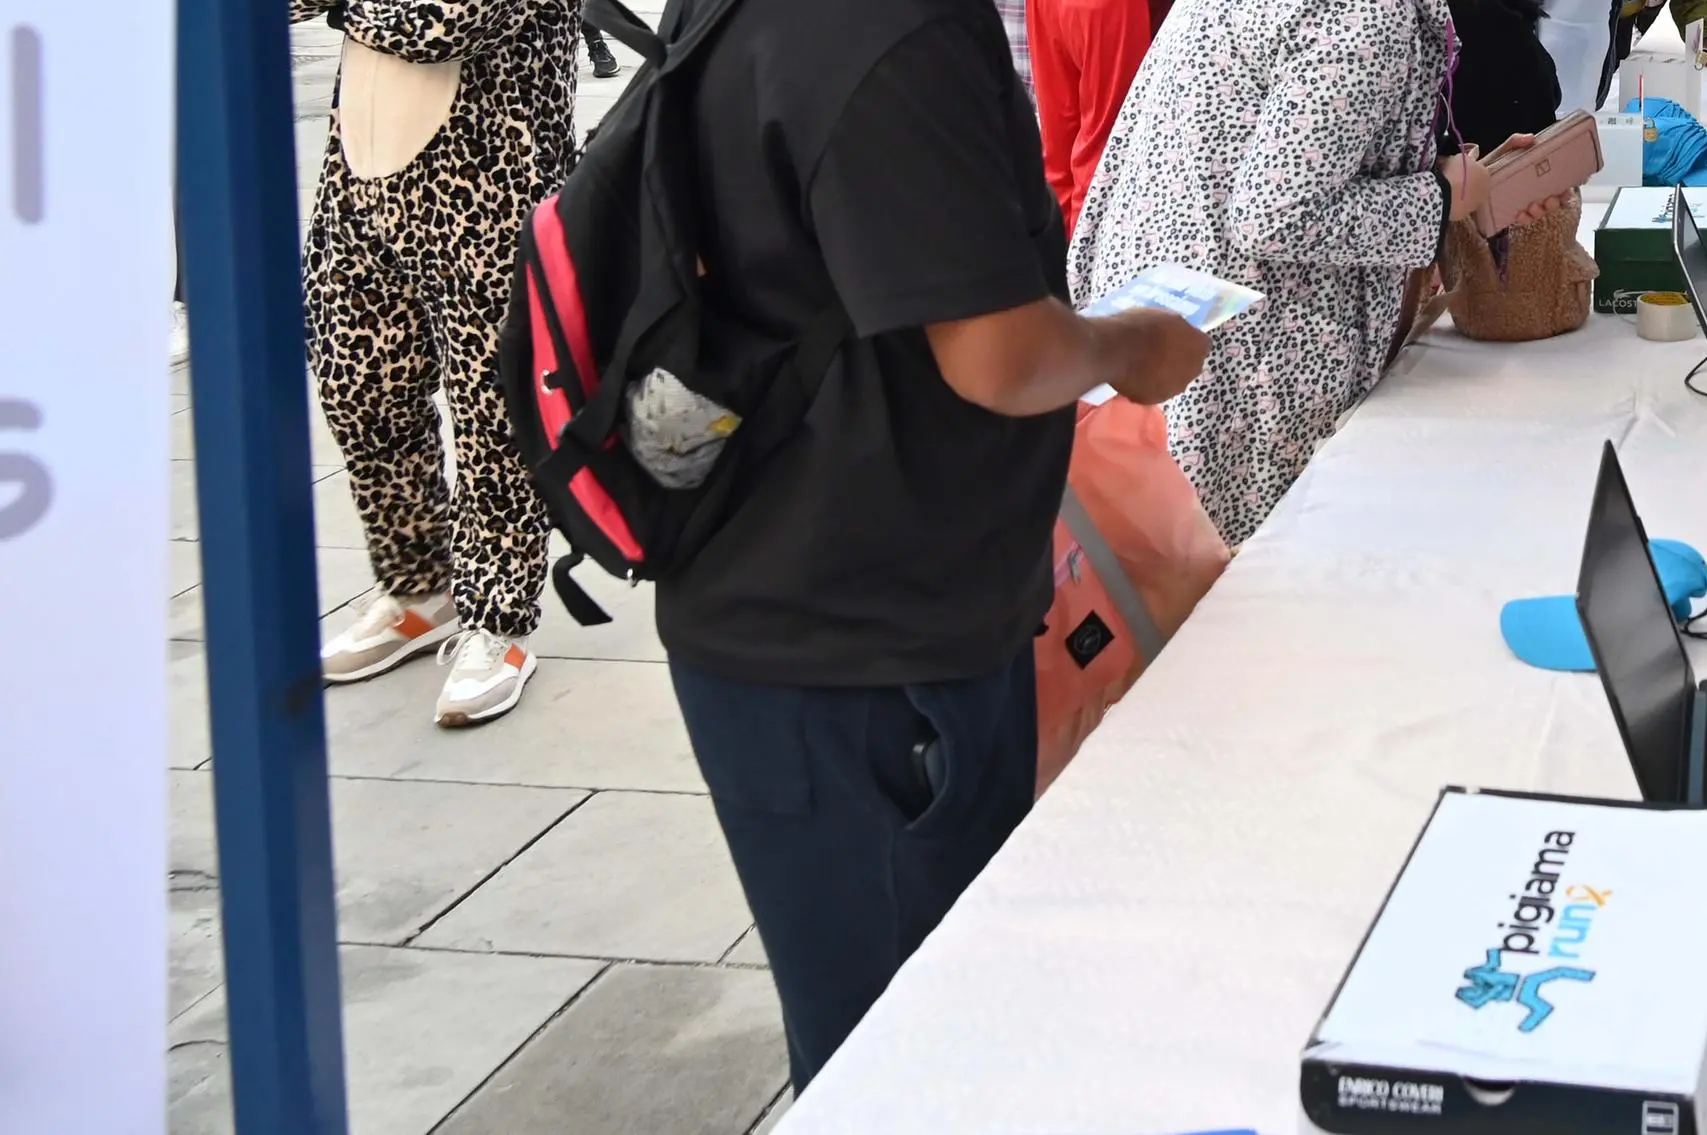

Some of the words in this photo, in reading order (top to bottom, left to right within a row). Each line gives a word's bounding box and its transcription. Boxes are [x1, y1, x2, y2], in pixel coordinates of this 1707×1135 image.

[1598, 299, 1638, 308] LACOST
[1498, 830, 1576, 955] pigiama
[1548, 902, 1598, 959] run
